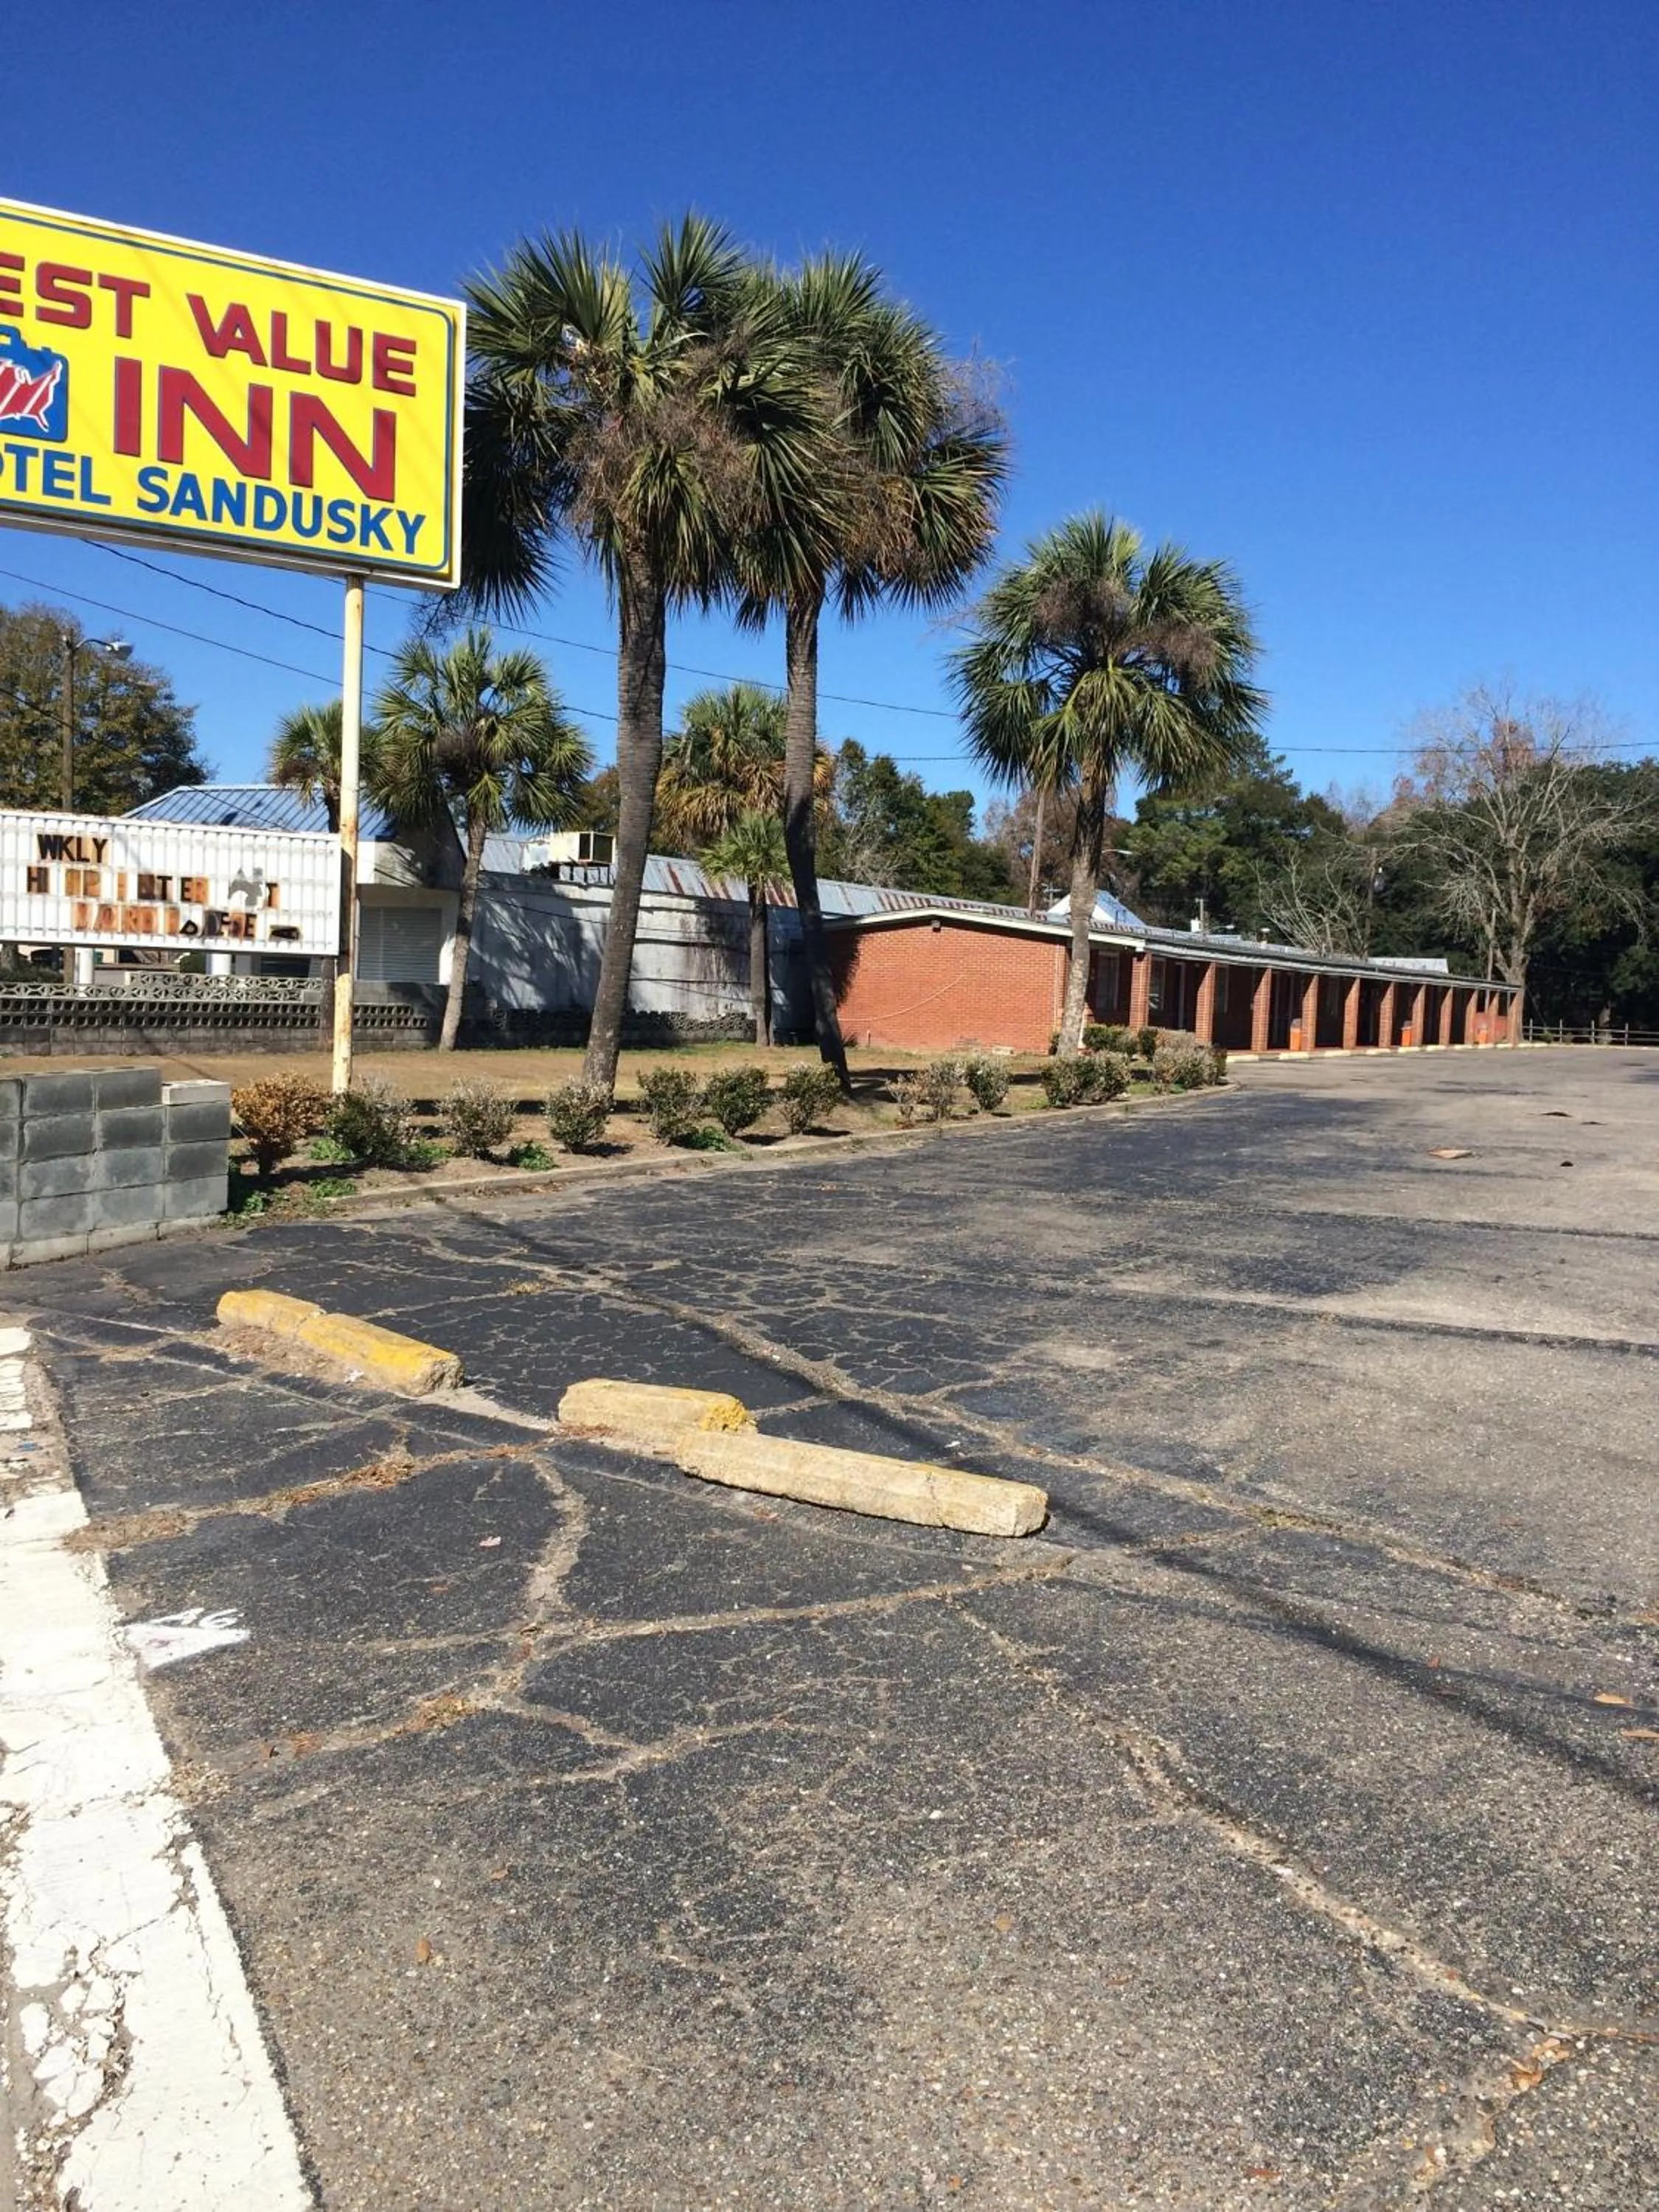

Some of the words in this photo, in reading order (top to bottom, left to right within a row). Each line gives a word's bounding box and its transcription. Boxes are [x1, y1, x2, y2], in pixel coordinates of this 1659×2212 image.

[187, 293, 417, 396] VALUE
[114, 356, 396, 502] INN
[0, 444, 111, 505] TEL
[138, 467, 425, 554] SANDUSKY
[37, 834, 107, 863] WKLY
